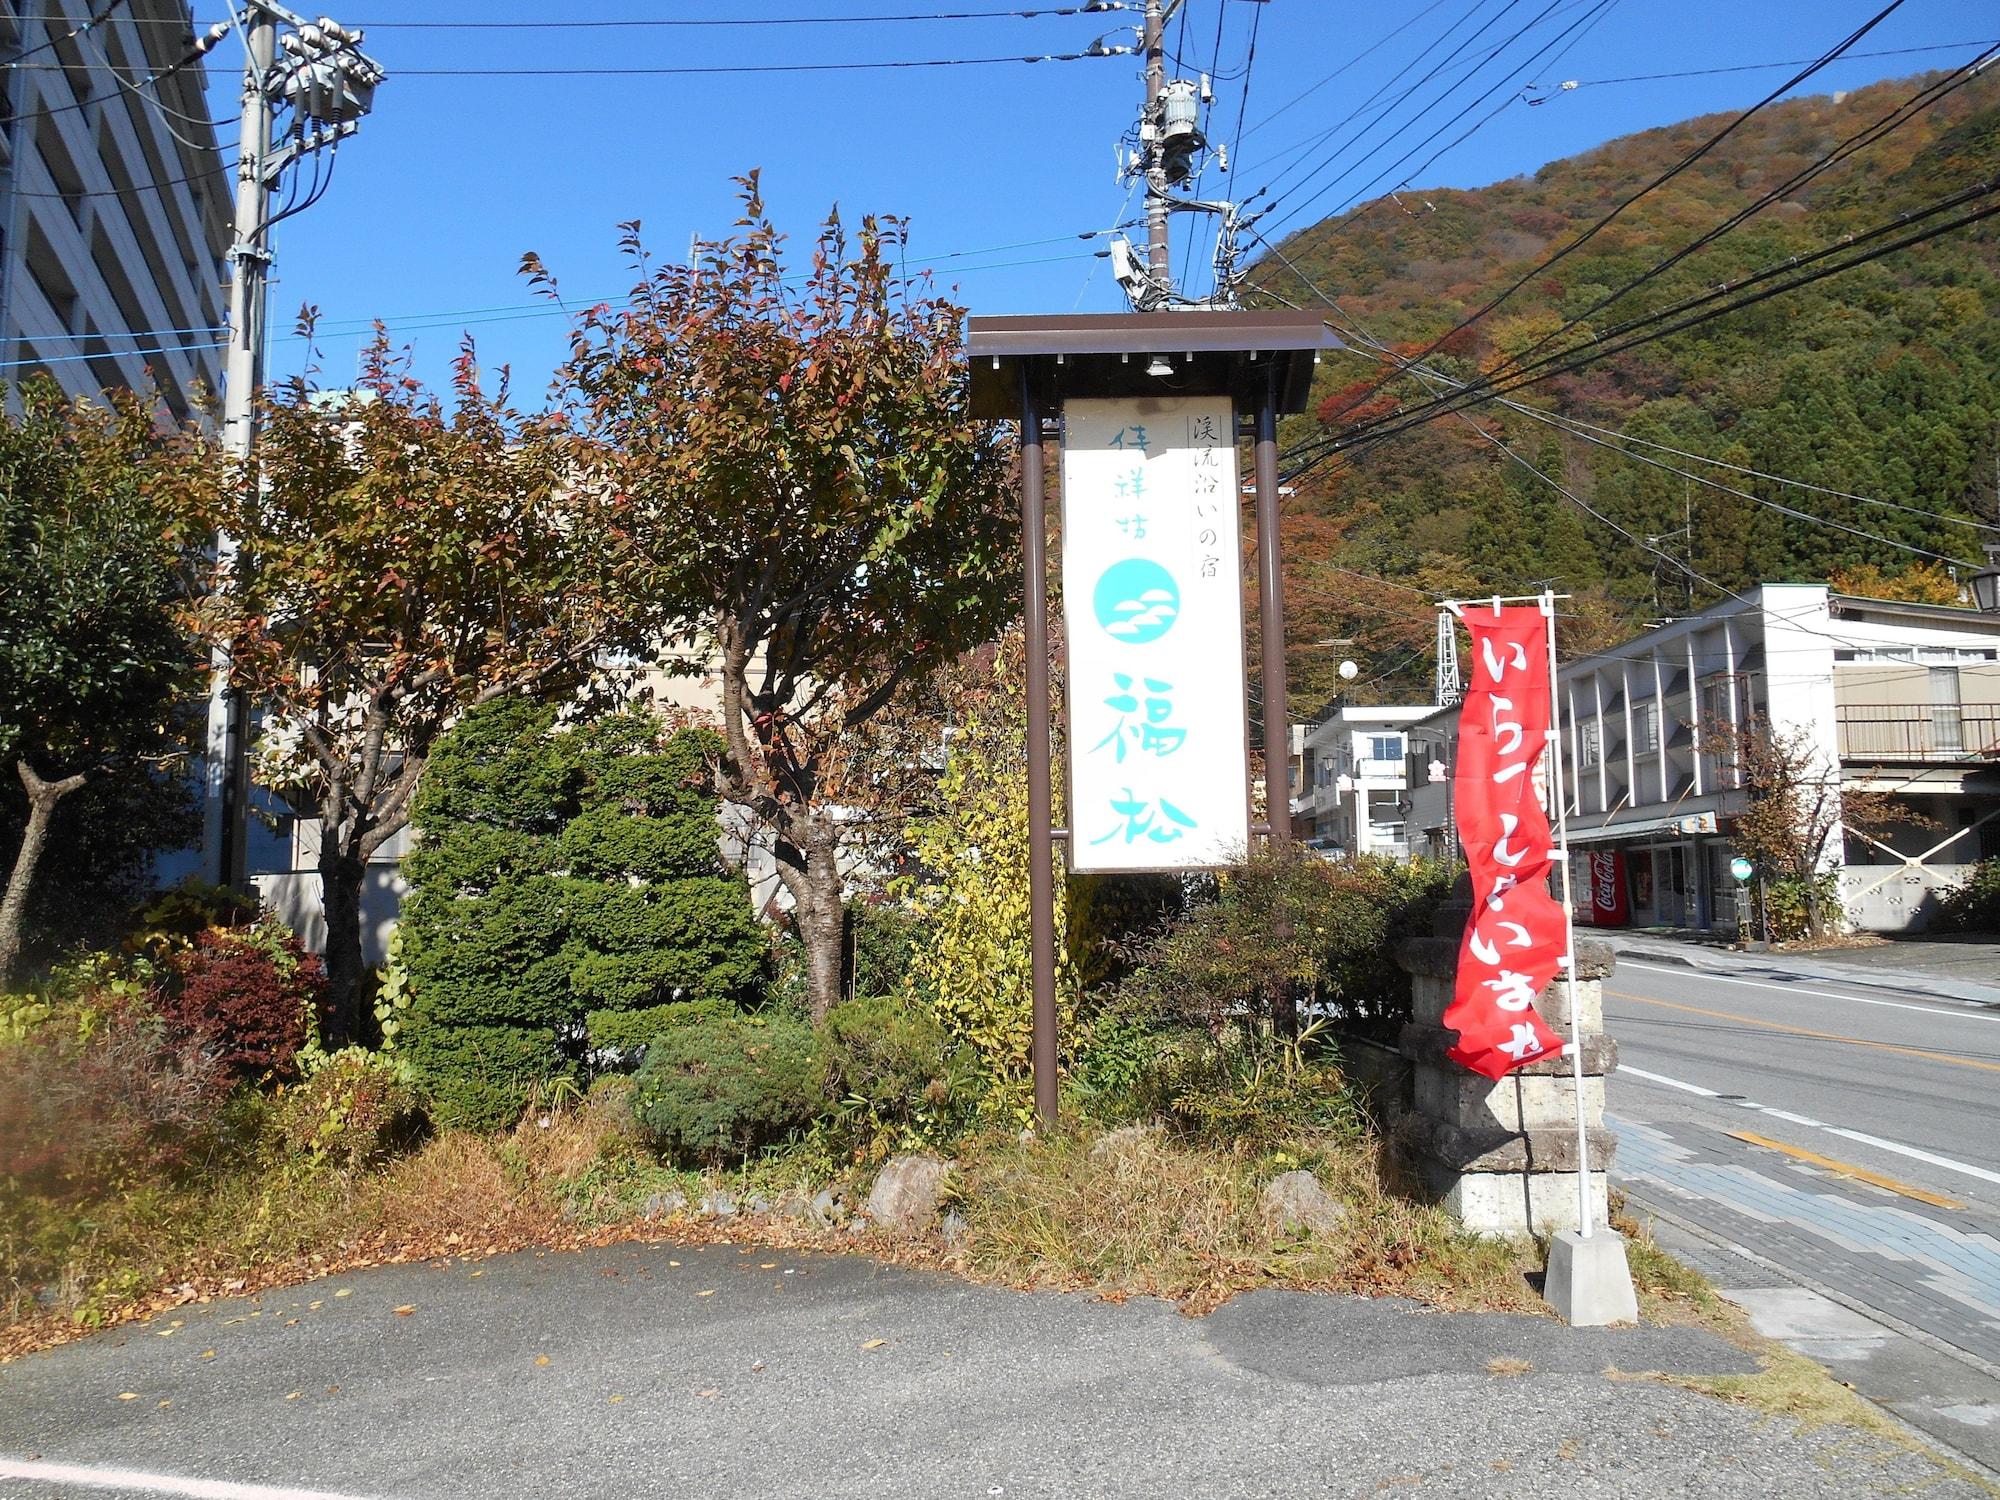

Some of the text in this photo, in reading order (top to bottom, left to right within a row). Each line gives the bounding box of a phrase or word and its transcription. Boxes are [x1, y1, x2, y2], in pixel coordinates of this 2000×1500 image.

[1194, 416, 1219, 578] 渓流沿いの宿
[1087, 672, 1198, 846] 福松
